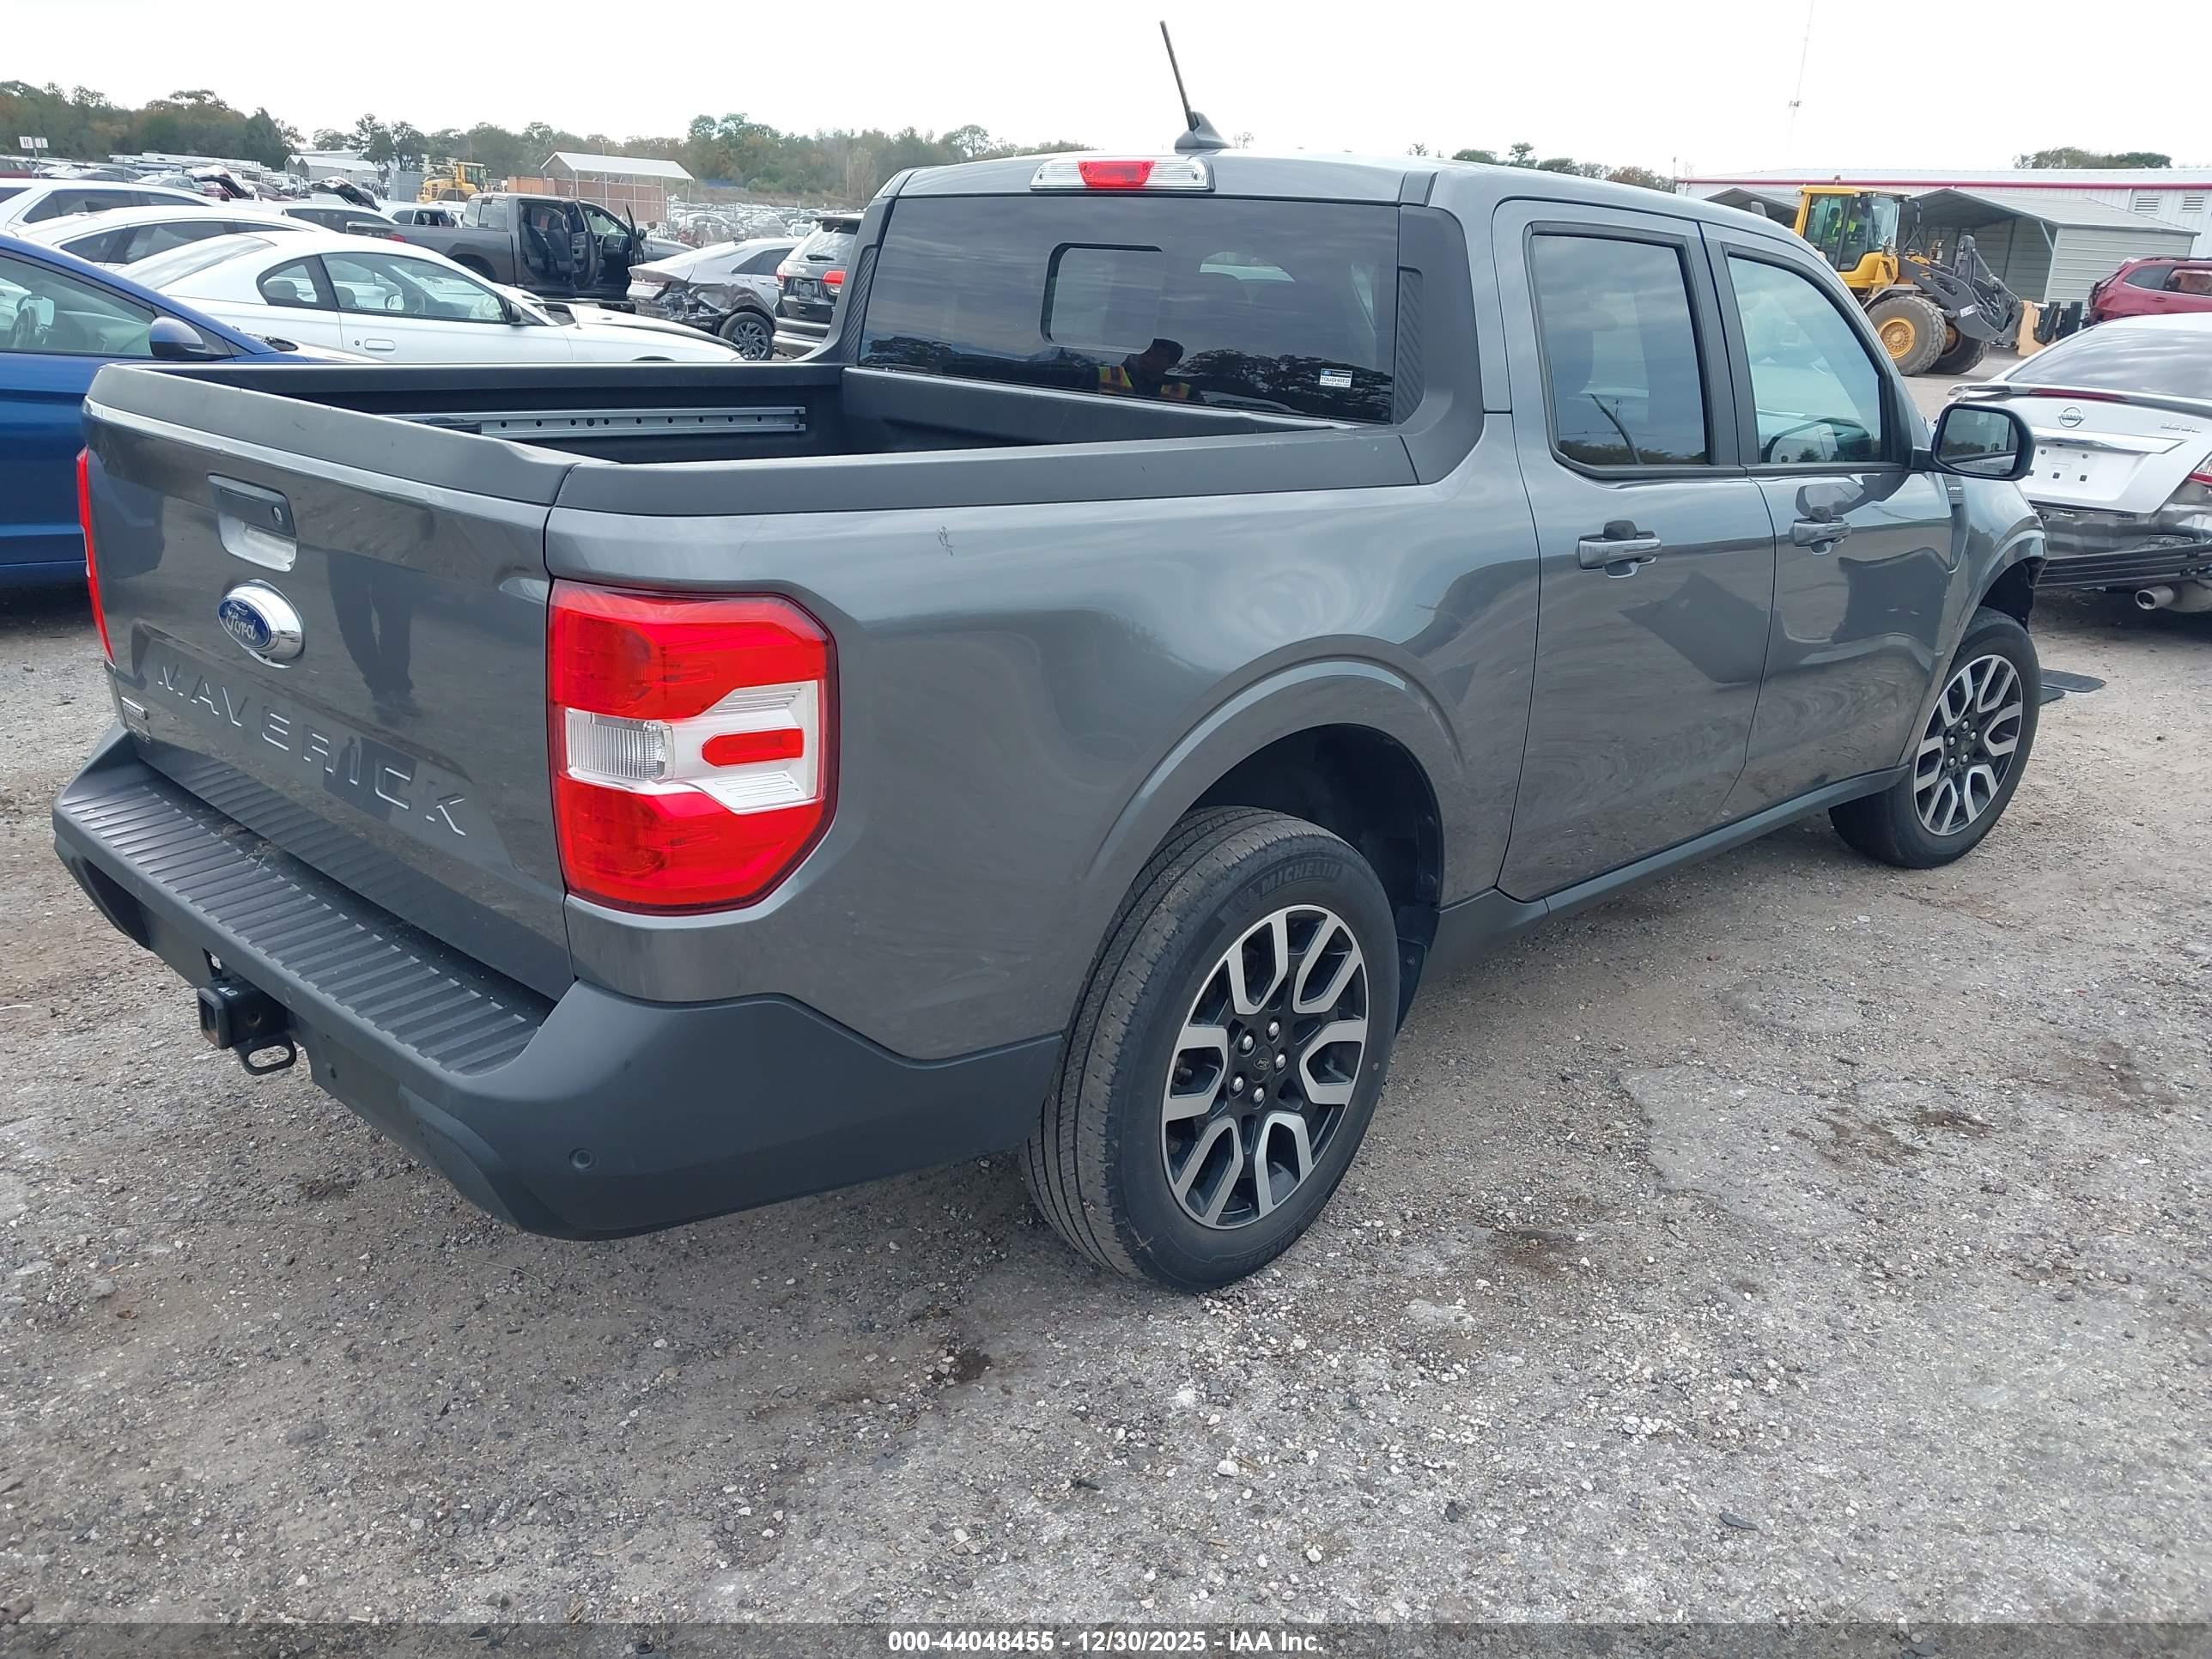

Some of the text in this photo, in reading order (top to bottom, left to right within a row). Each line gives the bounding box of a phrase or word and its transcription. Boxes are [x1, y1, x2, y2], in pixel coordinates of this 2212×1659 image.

[225, 603, 258, 641] Ford
[157, 663, 466, 836] MAVERICK
[1260, 861, 1341, 896] MICHELIN
